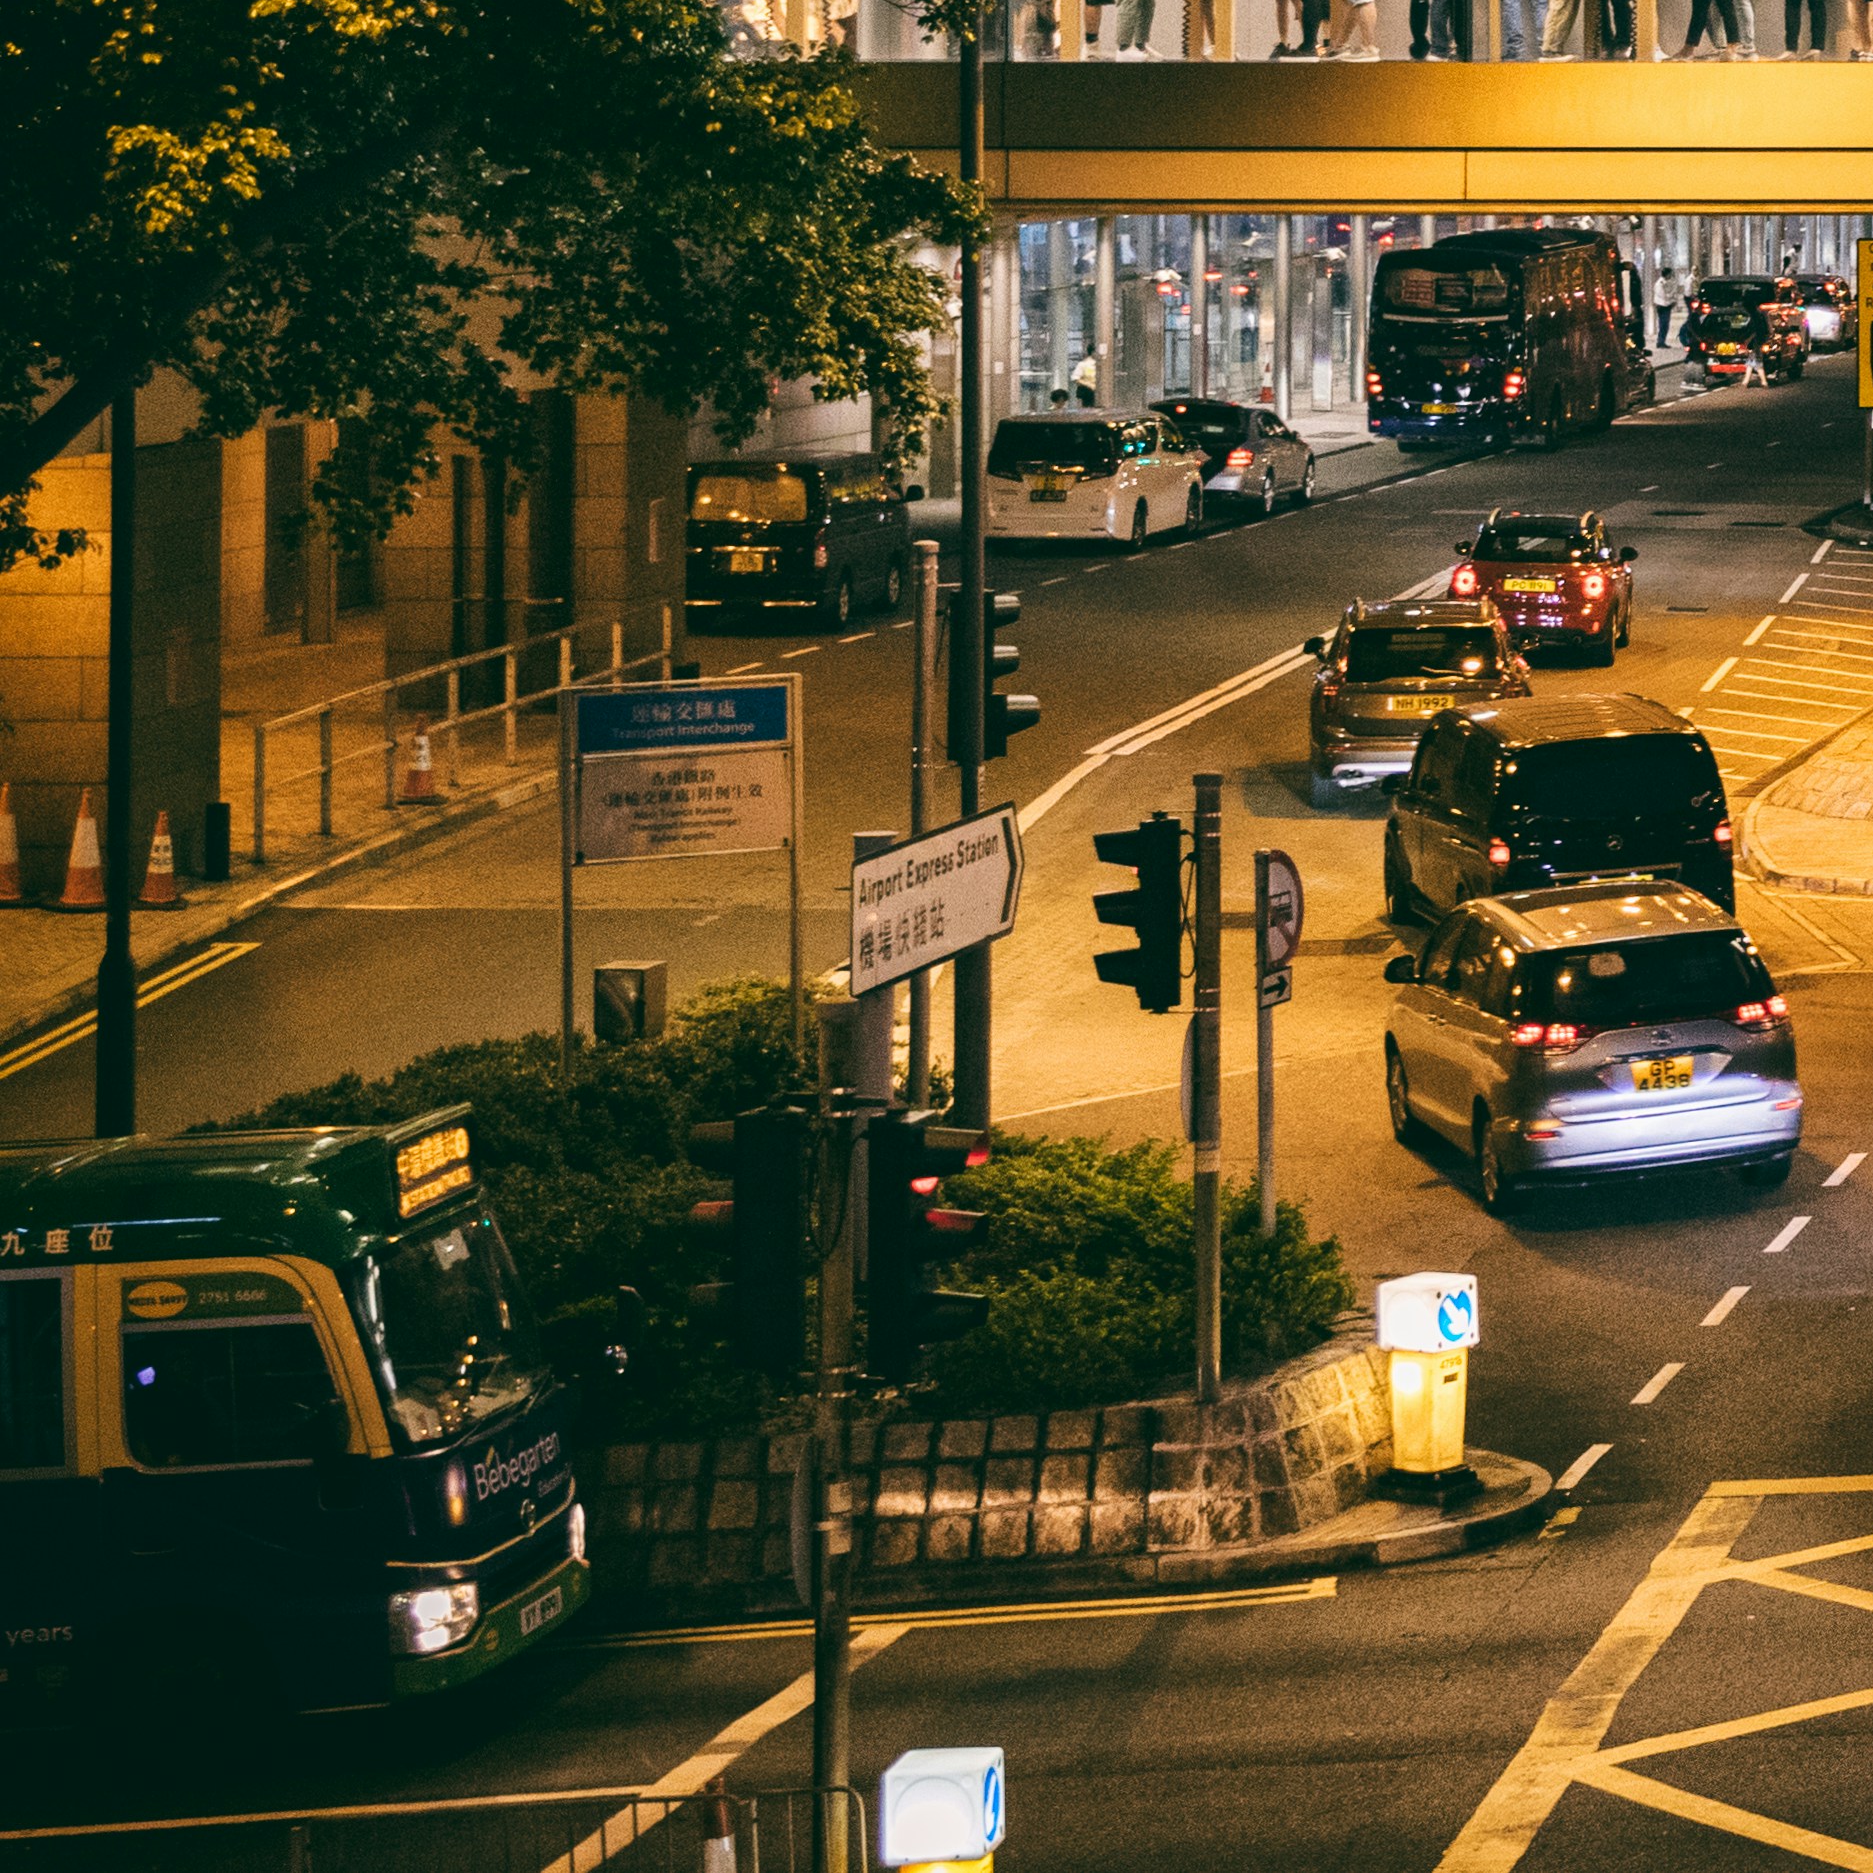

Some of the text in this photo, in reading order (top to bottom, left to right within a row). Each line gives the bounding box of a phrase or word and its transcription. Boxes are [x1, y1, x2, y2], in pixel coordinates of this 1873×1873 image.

[1511, 581, 1526, 590] PC
[1396, 697, 1449, 710] NH 1992
[612, 721, 756, 741] Transport Interchange
[859, 833, 999, 908] Airport Express Station
[1649, 1060, 1676, 1077] GP
[1638, 1074, 1691, 1092] 4438
[4, 1626, 74, 1647] years
